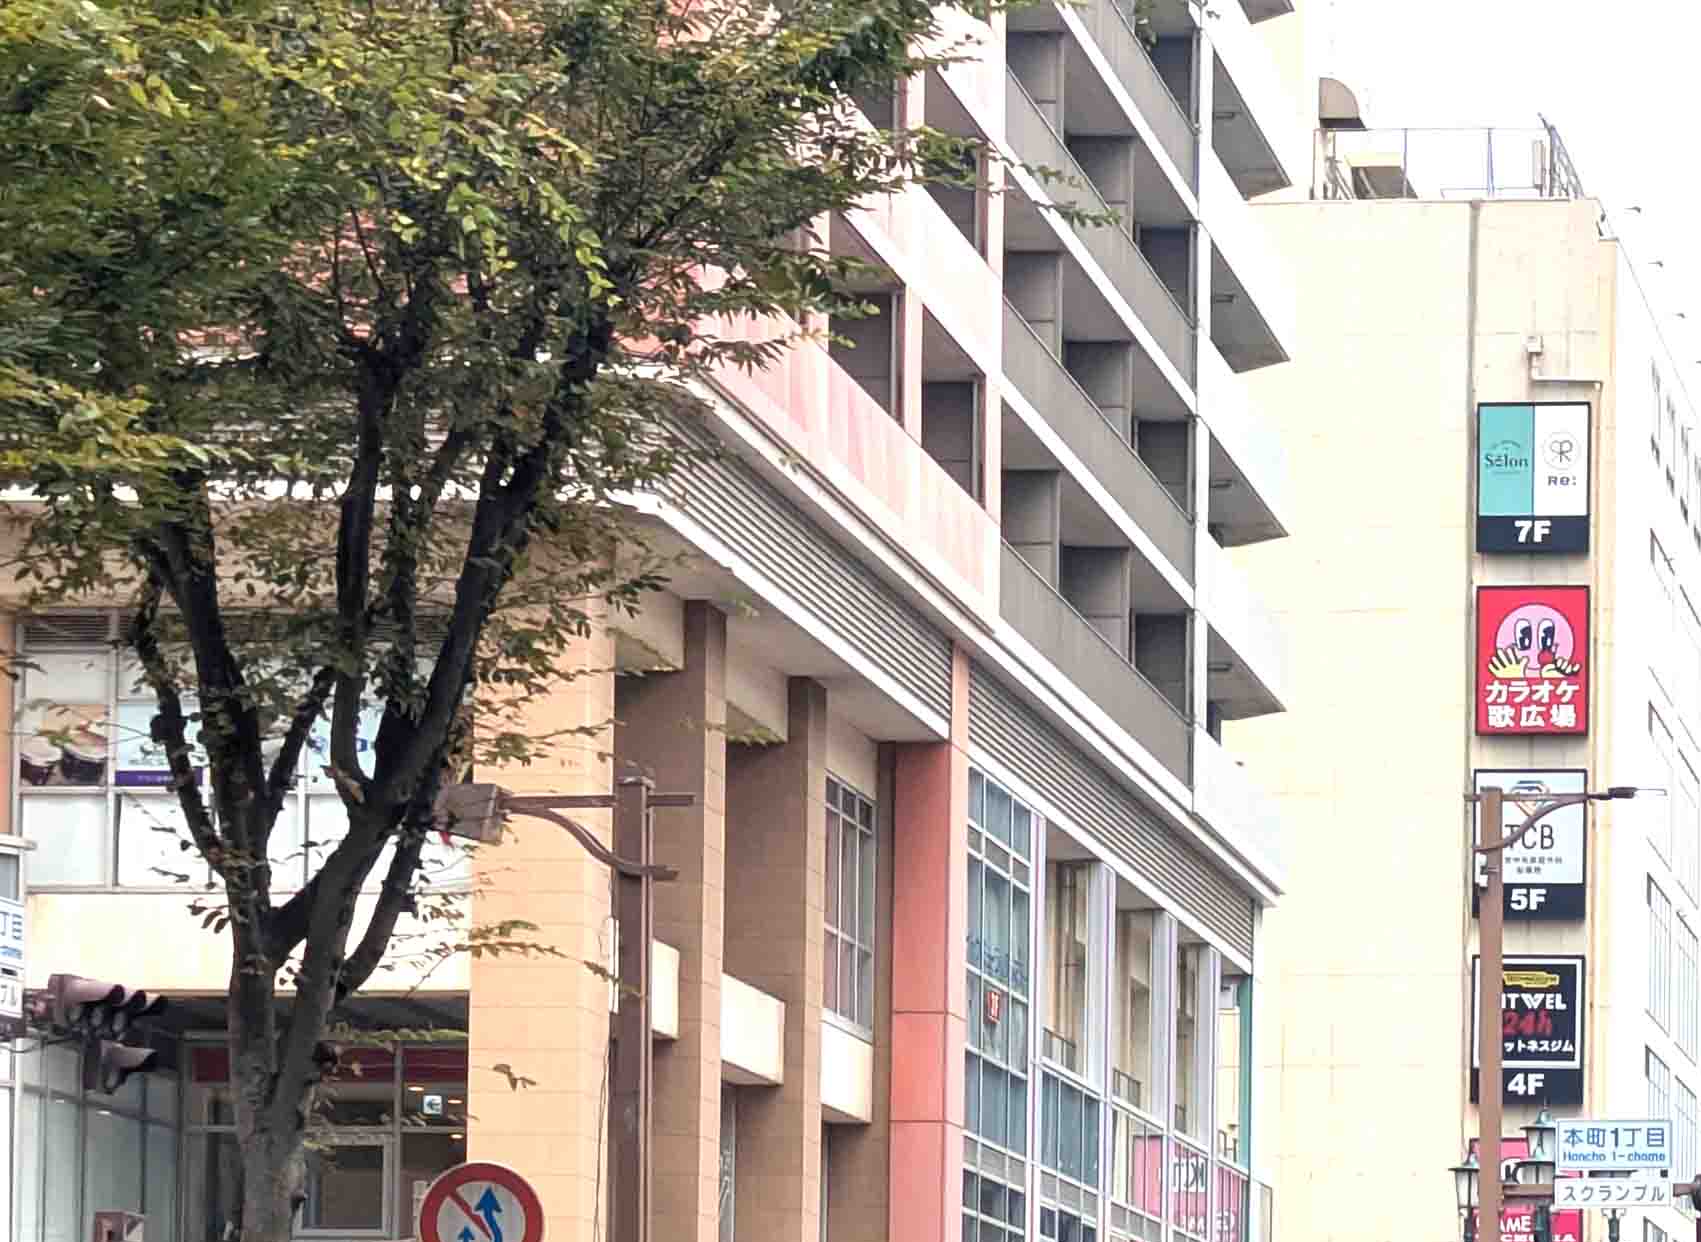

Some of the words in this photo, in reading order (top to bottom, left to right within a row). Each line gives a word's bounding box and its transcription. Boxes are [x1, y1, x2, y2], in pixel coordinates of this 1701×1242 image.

[1514, 519, 1552, 543] 7F
[1485, 681, 1580, 704] カラオケ
[1487, 705, 1577, 729] 歌広場
[1509, 888, 1548, 911] 5F
[1500, 993, 1568, 1011] ITWEL
[1507, 1072, 1546, 1096] 4F
[1563, 1127, 1665, 1148] 本町1丁目
[1563, 1151, 1607, 1162] Honcho
[1562, 1184, 1666, 1202] スクランブル
